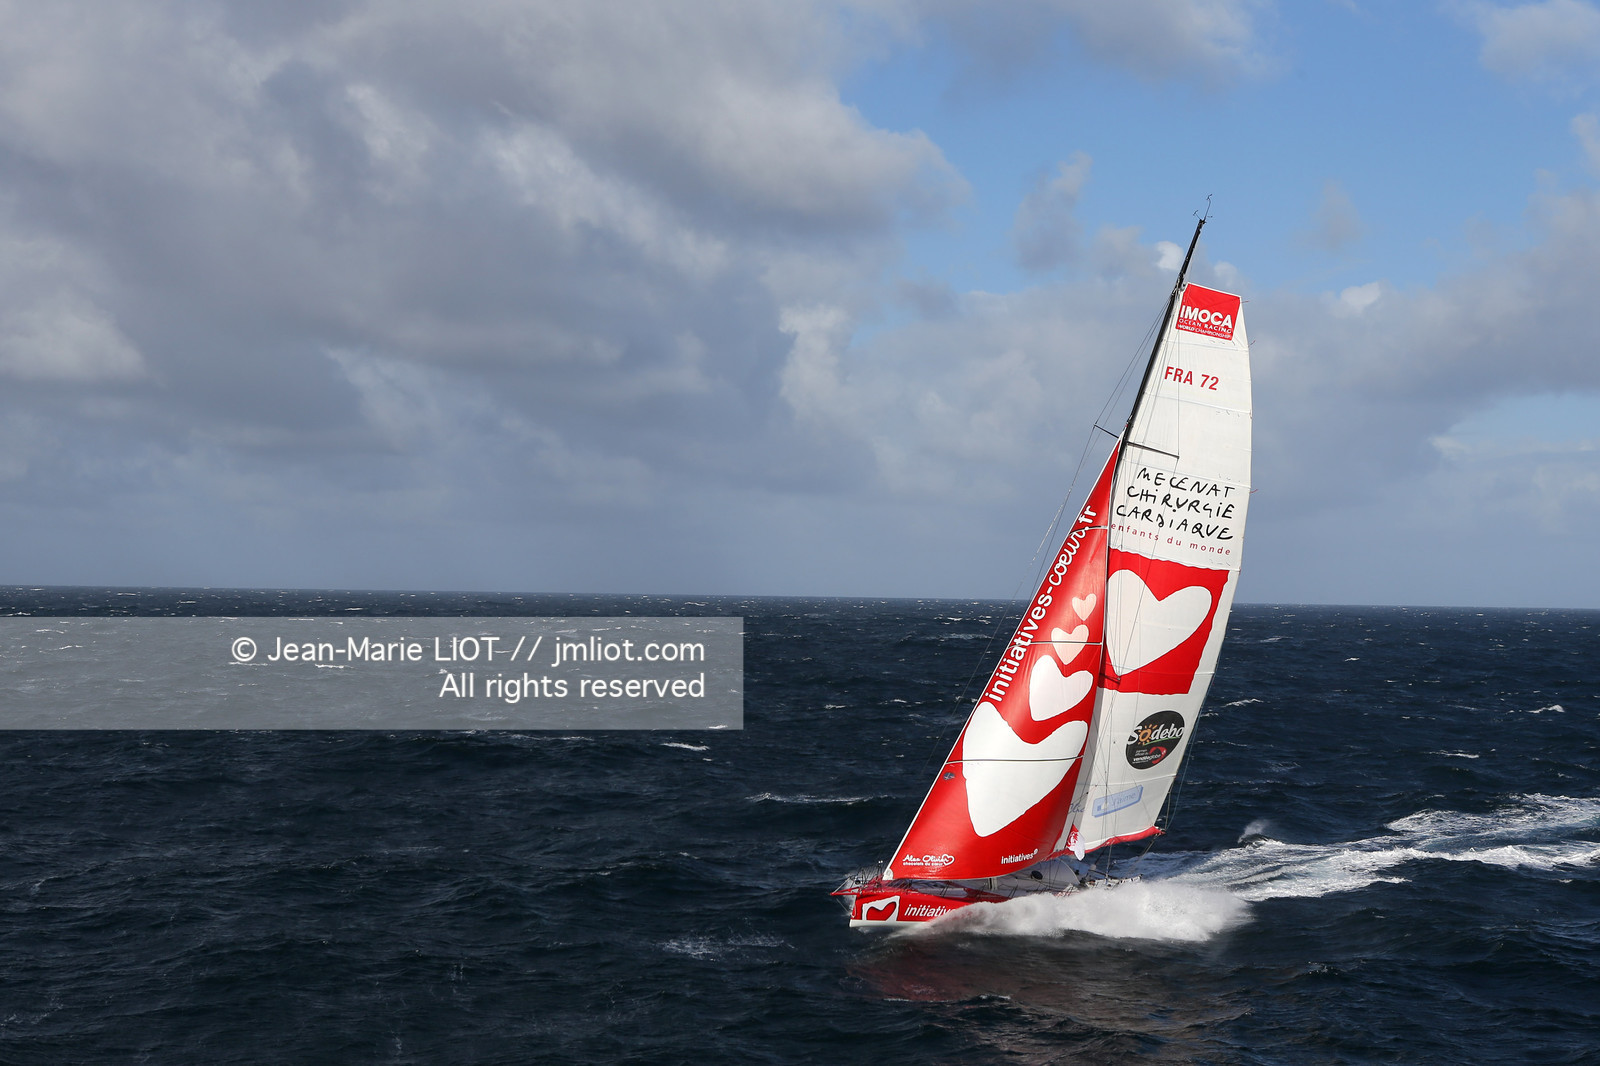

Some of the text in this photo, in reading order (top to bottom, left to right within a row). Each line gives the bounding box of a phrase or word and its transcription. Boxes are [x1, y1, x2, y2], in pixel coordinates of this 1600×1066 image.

[1179, 318, 1232, 334] OCEAN RACING
[1180, 305, 1233, 328] IMOCA
[1195, 327, 1231, 339] CHAMPIONSHIP
[1164, 366, 1219, 391] FRA 72
[1137, 467, 1235, 498] MECENAT
[1111, 522, 1231, 556] enfants du monde
[1127, 723, 1184, 745] Sodebo
[1001, 853, 1034, 864] initiatives
[904, 904, 957, 917] initiativ
